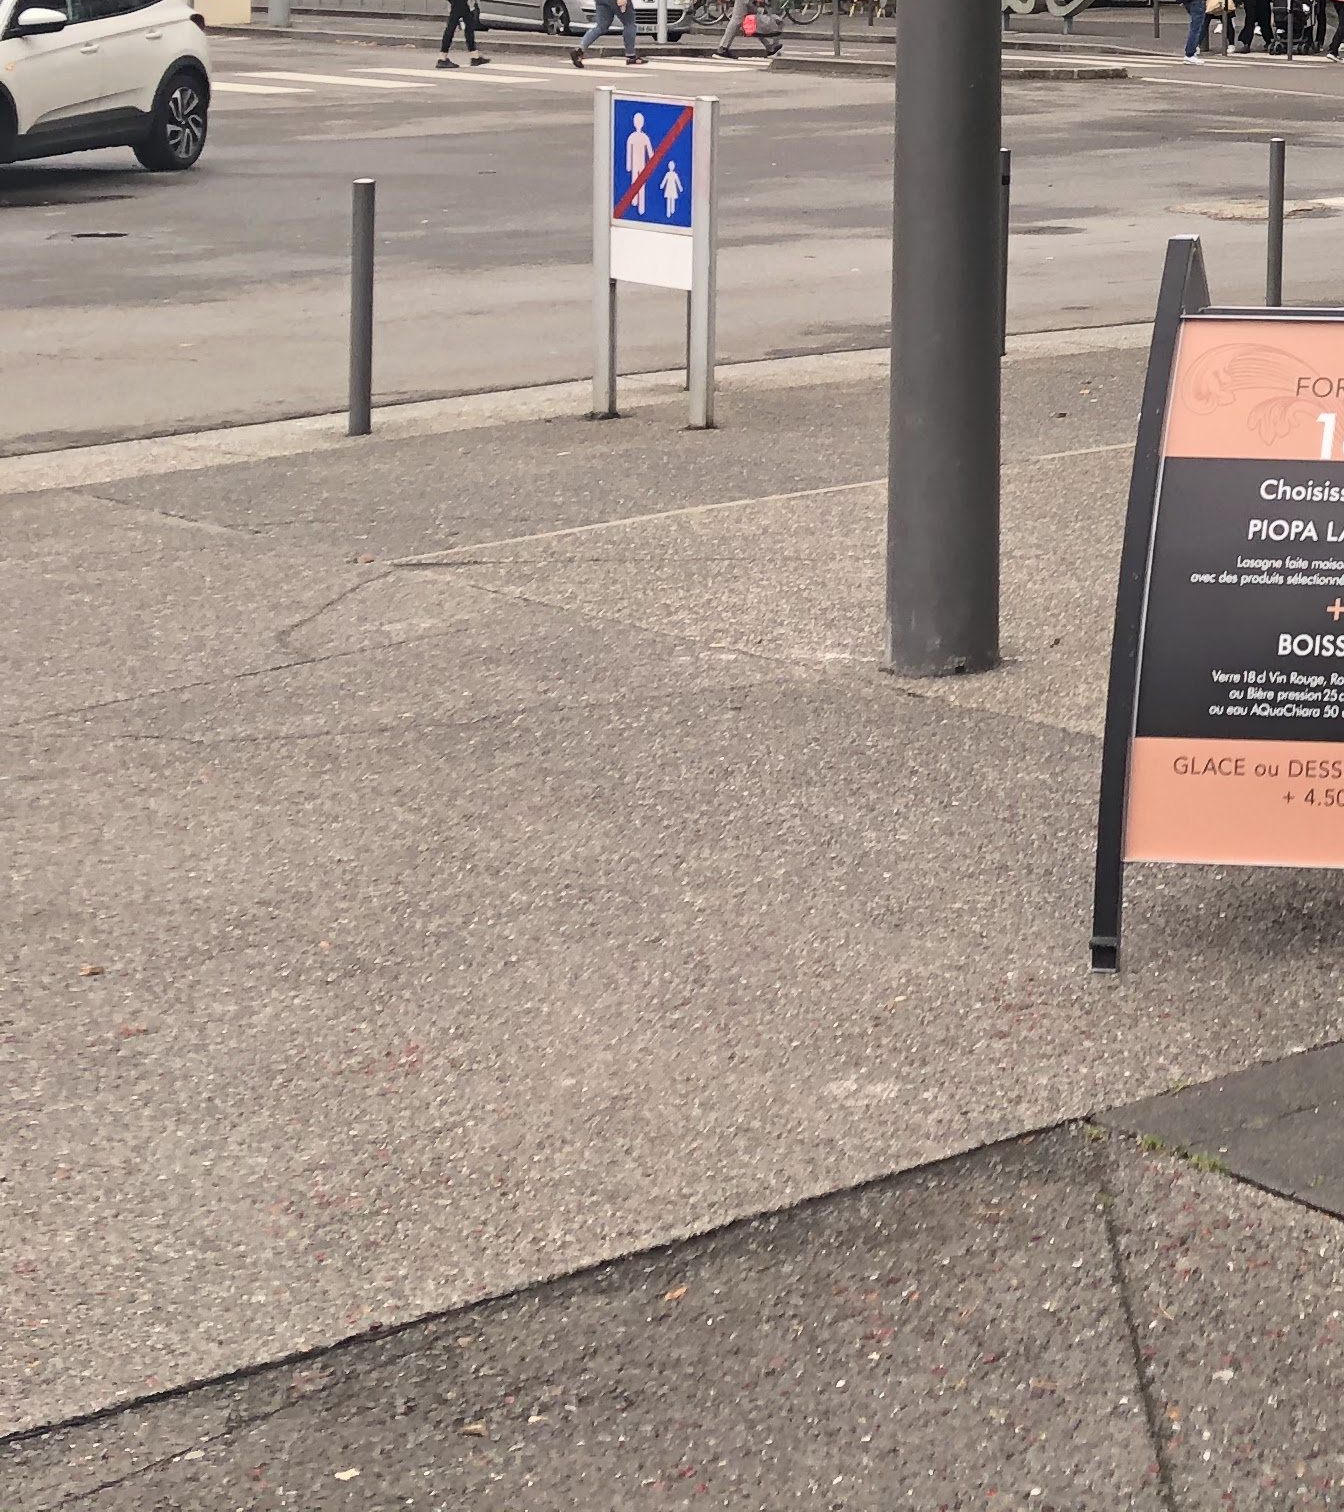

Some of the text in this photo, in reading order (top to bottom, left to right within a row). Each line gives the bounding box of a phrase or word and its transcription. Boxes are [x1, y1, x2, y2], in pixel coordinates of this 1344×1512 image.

[1248, 519, 1318, 541] PIOPA
[1237, 555, 1282, 570] Lasagne
[1285, 556, 1308, 569] faite
[1190, 573, 1216, 584] avec
[1218, 571, 1238, 584] des
[1240, 572, 1284, 586] produits
[1212, 670, 1241, 683] Verre
[1269, 671, 1287, 684] Vin
[1290, 672, 1327, 687] Rouge,
[1229, 689, 1244, 699] ou
[1247, 687, 1274, 700] Bière
[1276, 688, 1322, 703] pression
[1209, 705, 1224, 715] ou
[1226, 705, 1248, 715] eau
[1323, 705, 1339, 718] 50
[1173, 756, 1246, 776] GLACE
[1254, 763, 1279, 778] ou
